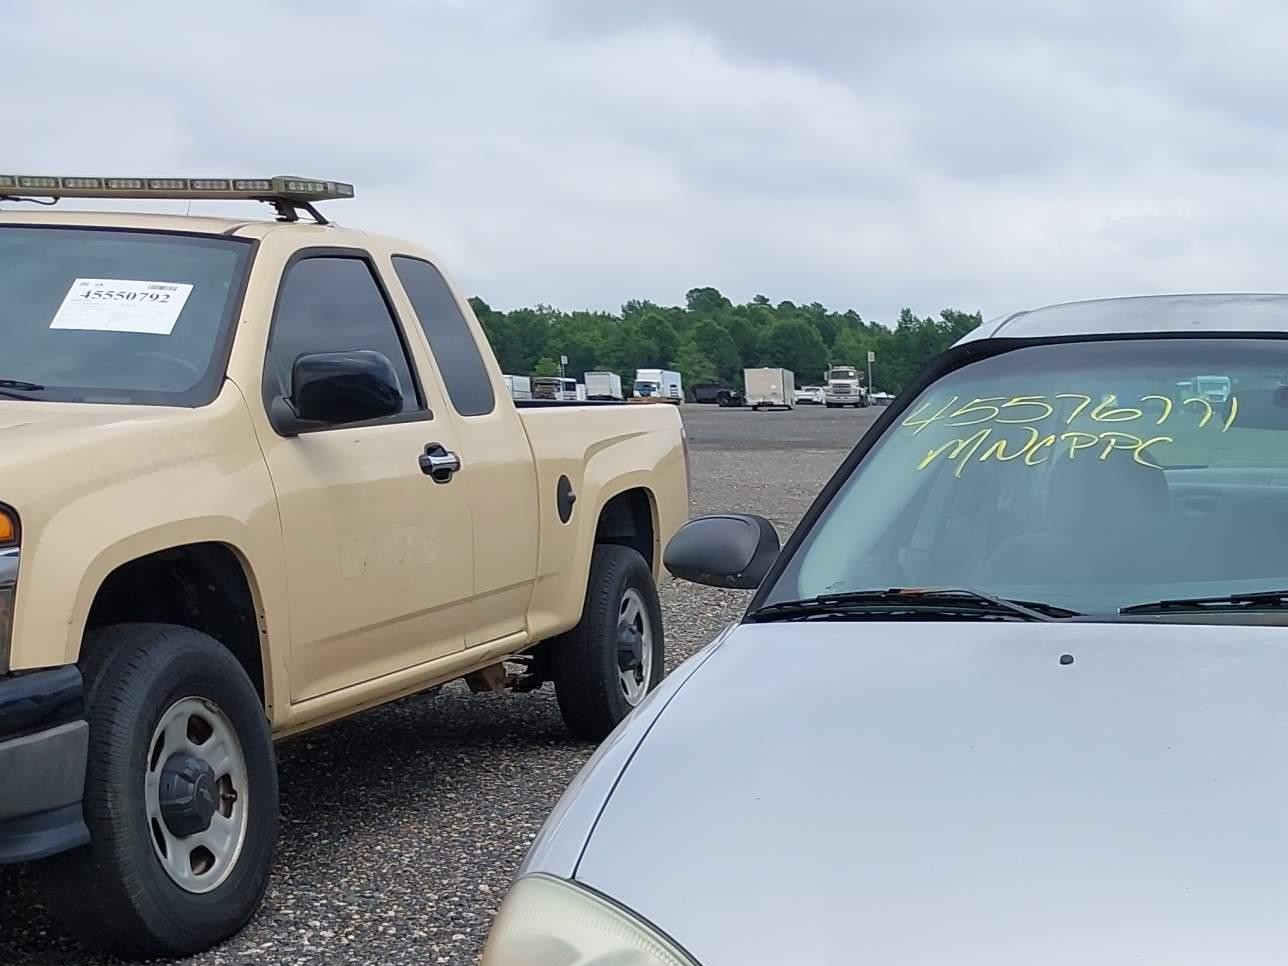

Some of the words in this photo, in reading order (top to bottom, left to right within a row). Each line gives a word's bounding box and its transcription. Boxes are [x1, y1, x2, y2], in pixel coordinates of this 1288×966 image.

[80, 290, 171, 303] 45550792
[902, 393, 1238, 435] 45576771
[916, 427, 1174, 478] MNCPPC
